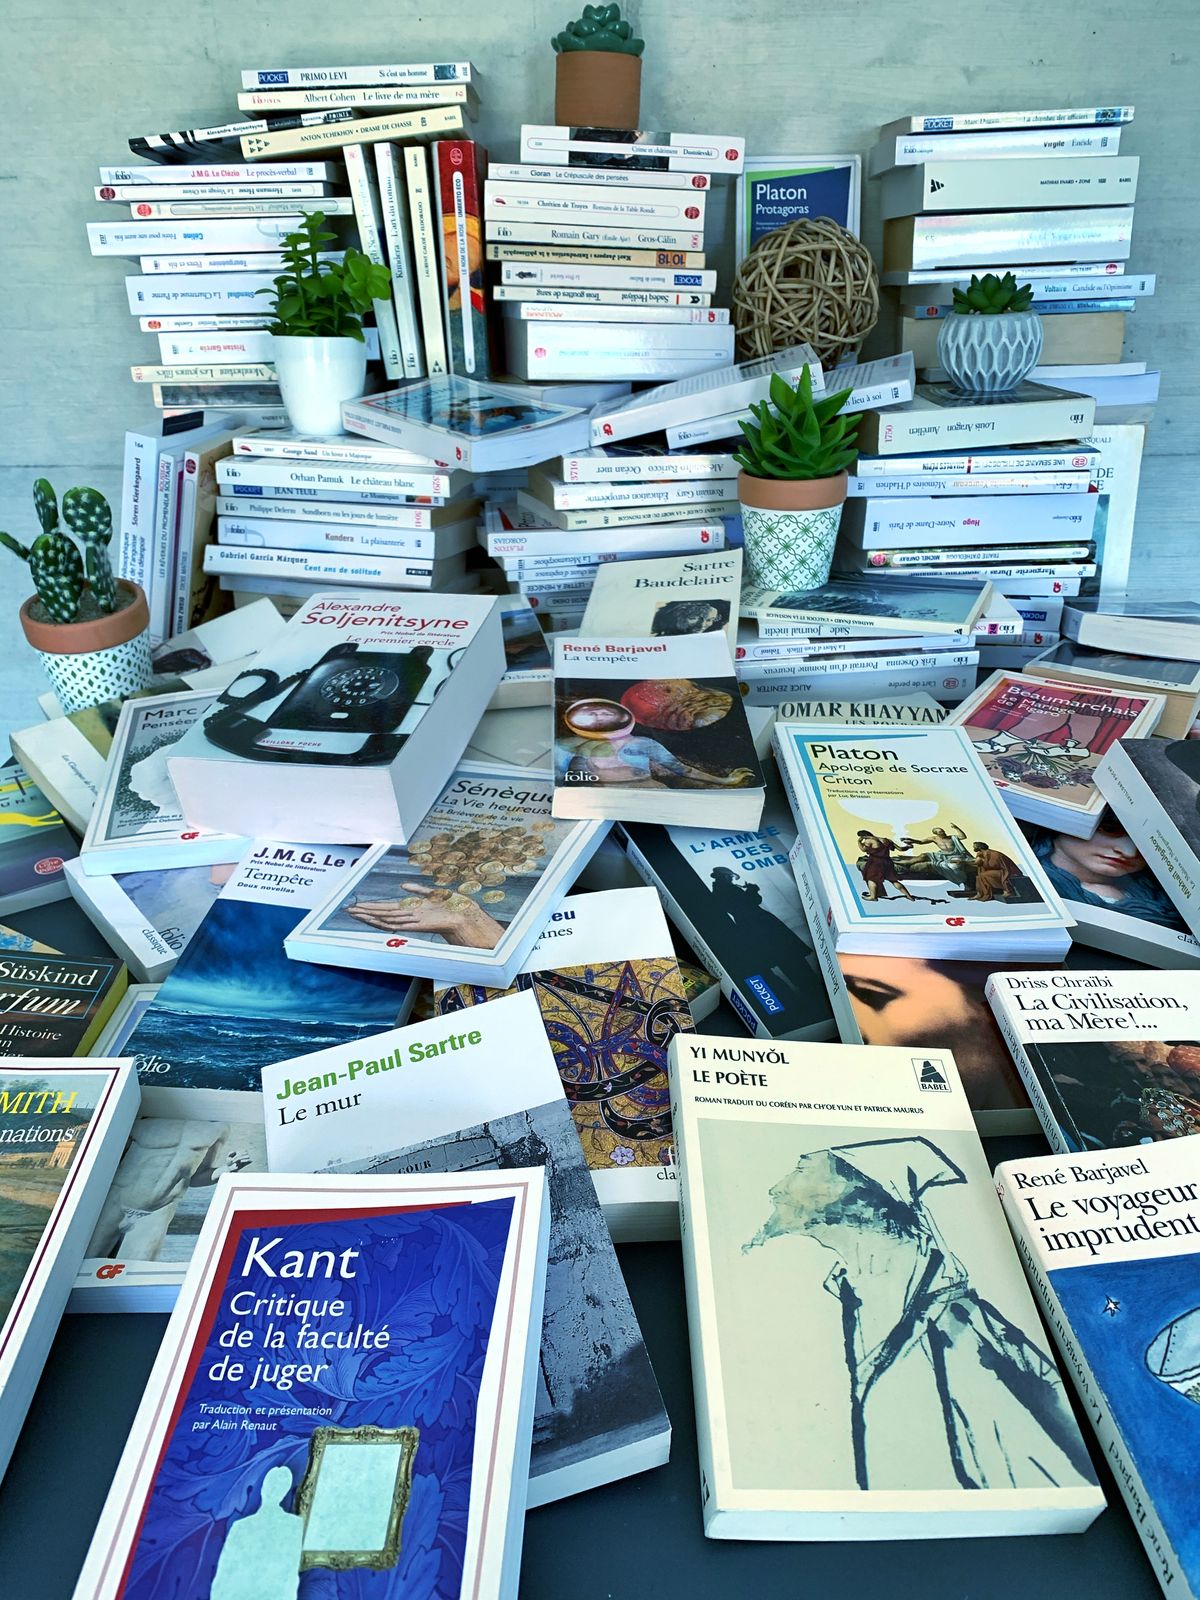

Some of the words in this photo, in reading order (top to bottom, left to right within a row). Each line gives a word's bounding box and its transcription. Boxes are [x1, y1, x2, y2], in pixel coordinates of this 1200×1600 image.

[259, 72, 288, 82] POCKET
[300, 72, 327, 81] PRIMO
[329, 71, 347, 80] LEVI
[304, 94, 327, 102] Albert
[330, 93, 355, 101] Cohen
[375, 92, 392, 100] livre
[394, 91, 404, 99] de
[419, 91, 440, 99] mère
[300, 133, 320, 142] ANTON
[323, 129, 354, 140] TCHEKHOV
[1044, 140, 1065, 148] Virgile
[257, 168, 297, 177] procès-verbal
[564, 171, 594, 182] Crépuscule
[607, 173, 629, 182] pensées
[756, 184, 807, 200] Platon
[455, 190, 464, 217] UMBERTO
[756, 204, 809, 217] Protagoras
[552, 229, 580, 239] Romain
[582, 231, 601, 242] Gary
[638, 234, 677, 244] Gros-Câlin
[391, 244, 404, 278] Kundera
[180, 291, 213, 299] Chartreuse
[222, 344, 246, 352] Tristan
[909, 425, 940, 436] Aurélien
[947, 422, 973, 433] Aragon
[975, 421, 995, 431] Louis
[283, 448, 302, 456] George
[615, 466, 641, 475] Océan
[648, 464, 678, 473] Baricco
[131, 457, 142, 503] Kierkegaard
[291, 473, 315, 483] Orhan
[317, 474, 344, 484] Pamuk
[351, 476, 362, 485] Le
[363, 476, 391, 487] château
[394, 477, 415, 488] blanc
[875, 481, 911, 490] d'Hadrien
[913, 481, 946, 489] Mémoires
[631, 492, 669, 504] Éducation
[676, 488, 694, 499] Gary
[696, 489, 724, 498] Romain
[889, 522, 904, 530] Paris
[915, 520, 956, 529] Notre-Dame
[963, 518, 980, 527] Hugo
[325, 532, 354, 542] Kundera
[370, 537, 405, 547] plaisanterie
[494, 545, 524, 553] PLATON
[220, 551, 247, 560] Gabriel
[250, 553, 274, 562] García
[277, 554, 308, 564] Márquez
[304, 564, 321, 572] Cent
[351, 567, 381, 576] solitude
[683, 559, 735, 573] Sartre
[1016, 568, 1055, 577] Marguerite
[990, 569, 1012, 577] Duras
[634, 574, 734, 589] Baudelaire
[311, 601, 402, 613] Alexandre
[301, 611, 470, 631] Soljenitsyne
[764, 627, 789, 637] inédit
[791, 624, 823, 636] Journal
[830, 626, 850, 635] Sade
[346, 635, 360, 644] Le
[363, 636, 415, 647] premier
[418, 638, 455, 647] cercle
[563, 644, 601, 653] René
[605, 644, 667, 654] Barjavel
[564, 654, 580, 662] La
[585, 655, 638, 663] tempête
[886, 659, 918, 668] Orsenna
[763, 667, 795, 676] heureux
[798, 665, 827, 673] homme
[851, 661, 878, 671] Portrait
[757, 685, 788, 693] ZENITER
[790, 684, 811, 692] ALICE
[888, 680, 911, 689] perdre
[1001, 694, 1017, 702] Le
[1021, 699, 1076, 714] Mariage
[1007, 686, 1139, 717] Beaumarchais
[144, 707, 198, 720] Marc
[781, 702, 843, 718] OMAR
[850, 702, 950, 723] KHAYYAM
[1018, 703, 1060, 717] Figaro
[141, 717, 198, 730] Pensées
[811, 743, 899, 761] Platon
[818, 762, 884, 774] Apologie
[891, 764, 907, 773] de
[911, 764, 968, 774] Socrate
[564, 770, 600, 782] folio
[822, 774, 873, 786] Criton
[441, 796, 458, 806] La
[462, 797, 486, 808] Vie
[180, 831, 200, 840] GF
[731, 843, 773, 860] DES
[323, 855, 345, 868] Le
[242, 867, 314, 887] Tempête
[237, 881, 258, 889] Deux
[260, 885, 295, 894] novellas
[945, 917, 967, 927] GF
[142, 928, 168, 955] classique
[159, 927, 184, 950] folio
[385, 938, 408, 948] GF
[0, 961, 98, 986] Süskind
[1007, 977, 1049, 990] Driss
[1051, 976, 1114, 990] Chraïbi
[0, 988, 81, 1015] rfum
[750, 978, 779, 1012] POCKET
[1014, 993, 1051, 1012] La
[1052, 993, 1189, 1013] Civilisation,
[1024, 1014, 1066, 1031] ma
[0, 1024, 63, 1041] Histoire
[690, 1046, 707, 1059] YI
[712, 1048, 790, 1065] MUNYŎL
[276, 1048, 403, 1100] Jean-Paul
[409, 1030, 482, 1063] Sartre
[693, 1070, 711, 1083] LE
[715, 1070, 768, 1087] POÈTE
[920, 1083, 950, 1092] BABEL
[0, 1091, 78, 1114] MITH
[278, 1106, 308, 1127] Le
[315, 1090, 362, 1117] mur
[694, 1096, 722, 1104] ROMAN
[723, 1098, 754, 1106] TRADUIT
[756, 1100, 768, 1108] DU
[769, 1100, 798, 1109] CORÉEN
[799, 1102, 812, 1110] PAR
[813, 1103, 836, 1111] CH'OE
[837, 1104, 853, 1112] YUN
[864, 1105, 892, 1113] PATRICK
[893, 1106, 924, 1114] MAURUS
[1, 1125, 76, 1144] nations
[397, 1159, 432, 1174] COUR
[1012, 1169, 1068, 1190] René
[1068, 1158, 1150, 1188] Barjavel
[1024, 1196, 1068, 1221] Le
[1072, 1182, 1199, 1220] voyageur
[1040, 1212, 1200, 1256] imprudent
[241, 1237, 360, 1279] Kant
[96, 1264, 125, 1279] GF
[230, 1291, 345, 1324] Critique
[219, 1323, 254, 1348] de
[263, 1324, 285, 1349] la
[296, 1324, 390, 1349] faculté
[208, 1355, 244, 1381] de
[250, 1357, 329, 1391] juger
[199, 1403, 252, 1415] Traduction
[255, 1405, 266, 1416] et
[268, 1405, 332, 1418] présentation
[192, 1420, 211, 1432] par
[211, 1420, 237, 1430] Alain
[240, 1420, 277, 1431] Renaut
